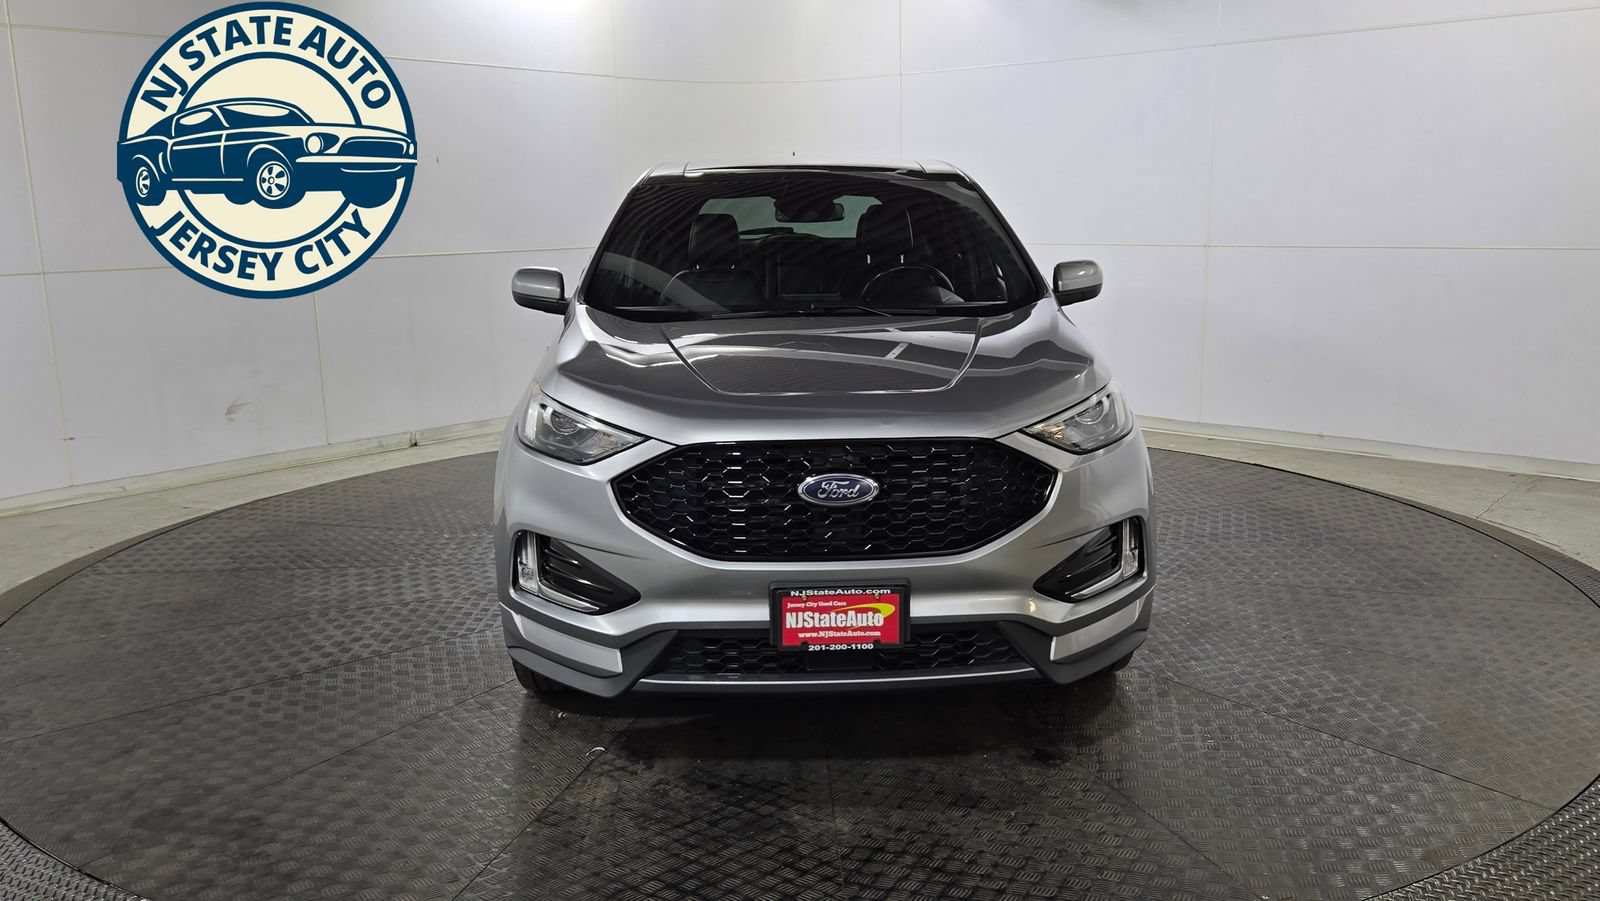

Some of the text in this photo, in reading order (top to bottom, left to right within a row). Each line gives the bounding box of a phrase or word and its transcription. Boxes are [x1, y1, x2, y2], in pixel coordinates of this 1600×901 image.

[817, 480, 860, 498] Ford
[790, 588, 891, 597] NJStateAuto.com
[785, 610, 884, 628] NJStateAuto
[798, 630, 881, 638] www.NJStateAuto.com
[808, 643, 874, 651] 201-200-1100
